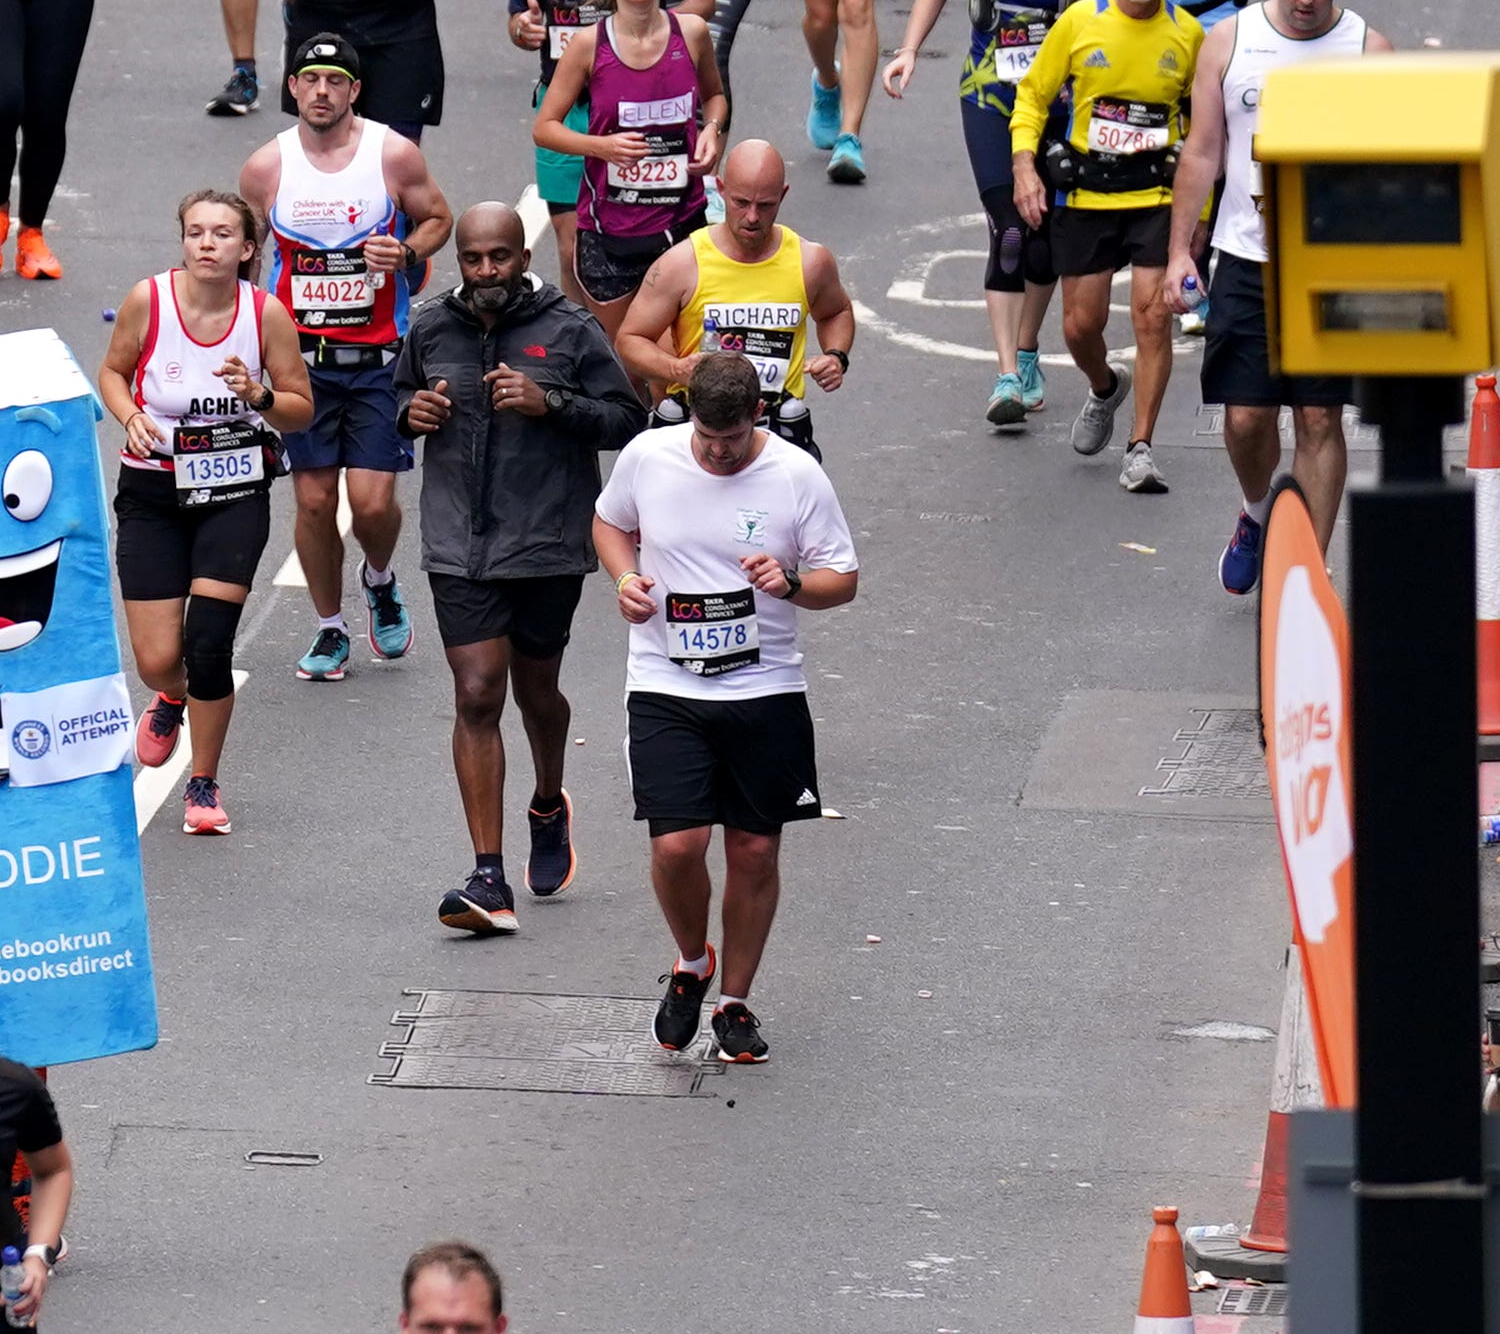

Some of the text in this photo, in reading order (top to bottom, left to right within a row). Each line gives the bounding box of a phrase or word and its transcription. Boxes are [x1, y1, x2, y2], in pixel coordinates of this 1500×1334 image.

[622, 101, 687, 123] ELLEN
[1096, 127, 1157, 150] 50786
[292, 208, 335, 218] Cancer UK
[293, 200, 325, 209] Children
[297, 258, 323, 274] tcs
[301, 279, 366, 303] 44022
[708, 304, 800, 327] RICHARD
[212, 427, 231, 435] TATA
[212, 430, 254, 442] CONSULTANCY
[180, 432, 208, 450] tcs
[185, 454, 253, 481] 13505
[670, 601, 702, 619] tcs
[704, 600, 749, 613] CONSULTANCY
[704, 608, 735, 618] SERVICES
[679, 624, 748, 651] 14578
[58, 708, 129, 732] OFFICIAL
[61, 721, 130, 746] ATTEMPT
